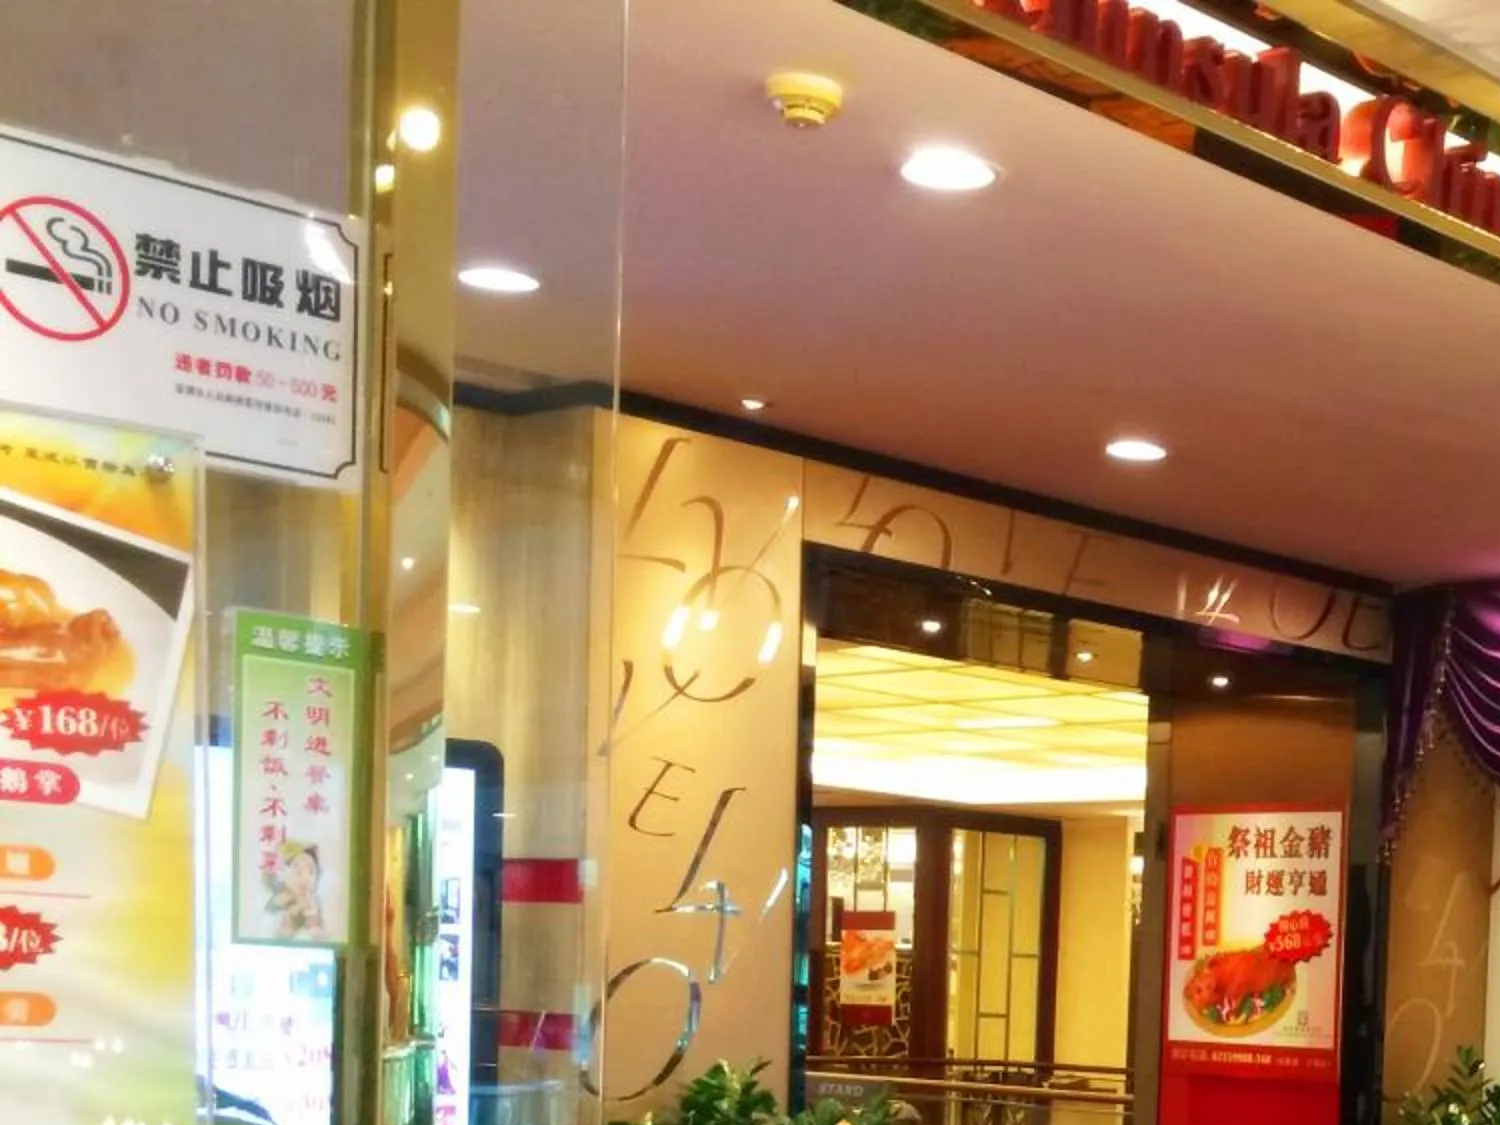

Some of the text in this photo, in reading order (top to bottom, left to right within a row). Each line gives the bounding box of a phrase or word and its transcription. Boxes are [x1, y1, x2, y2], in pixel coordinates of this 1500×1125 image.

[134, 233, 340, 322] 禁止吸烟
[137, 297, 341, 361] NO SMOKING
